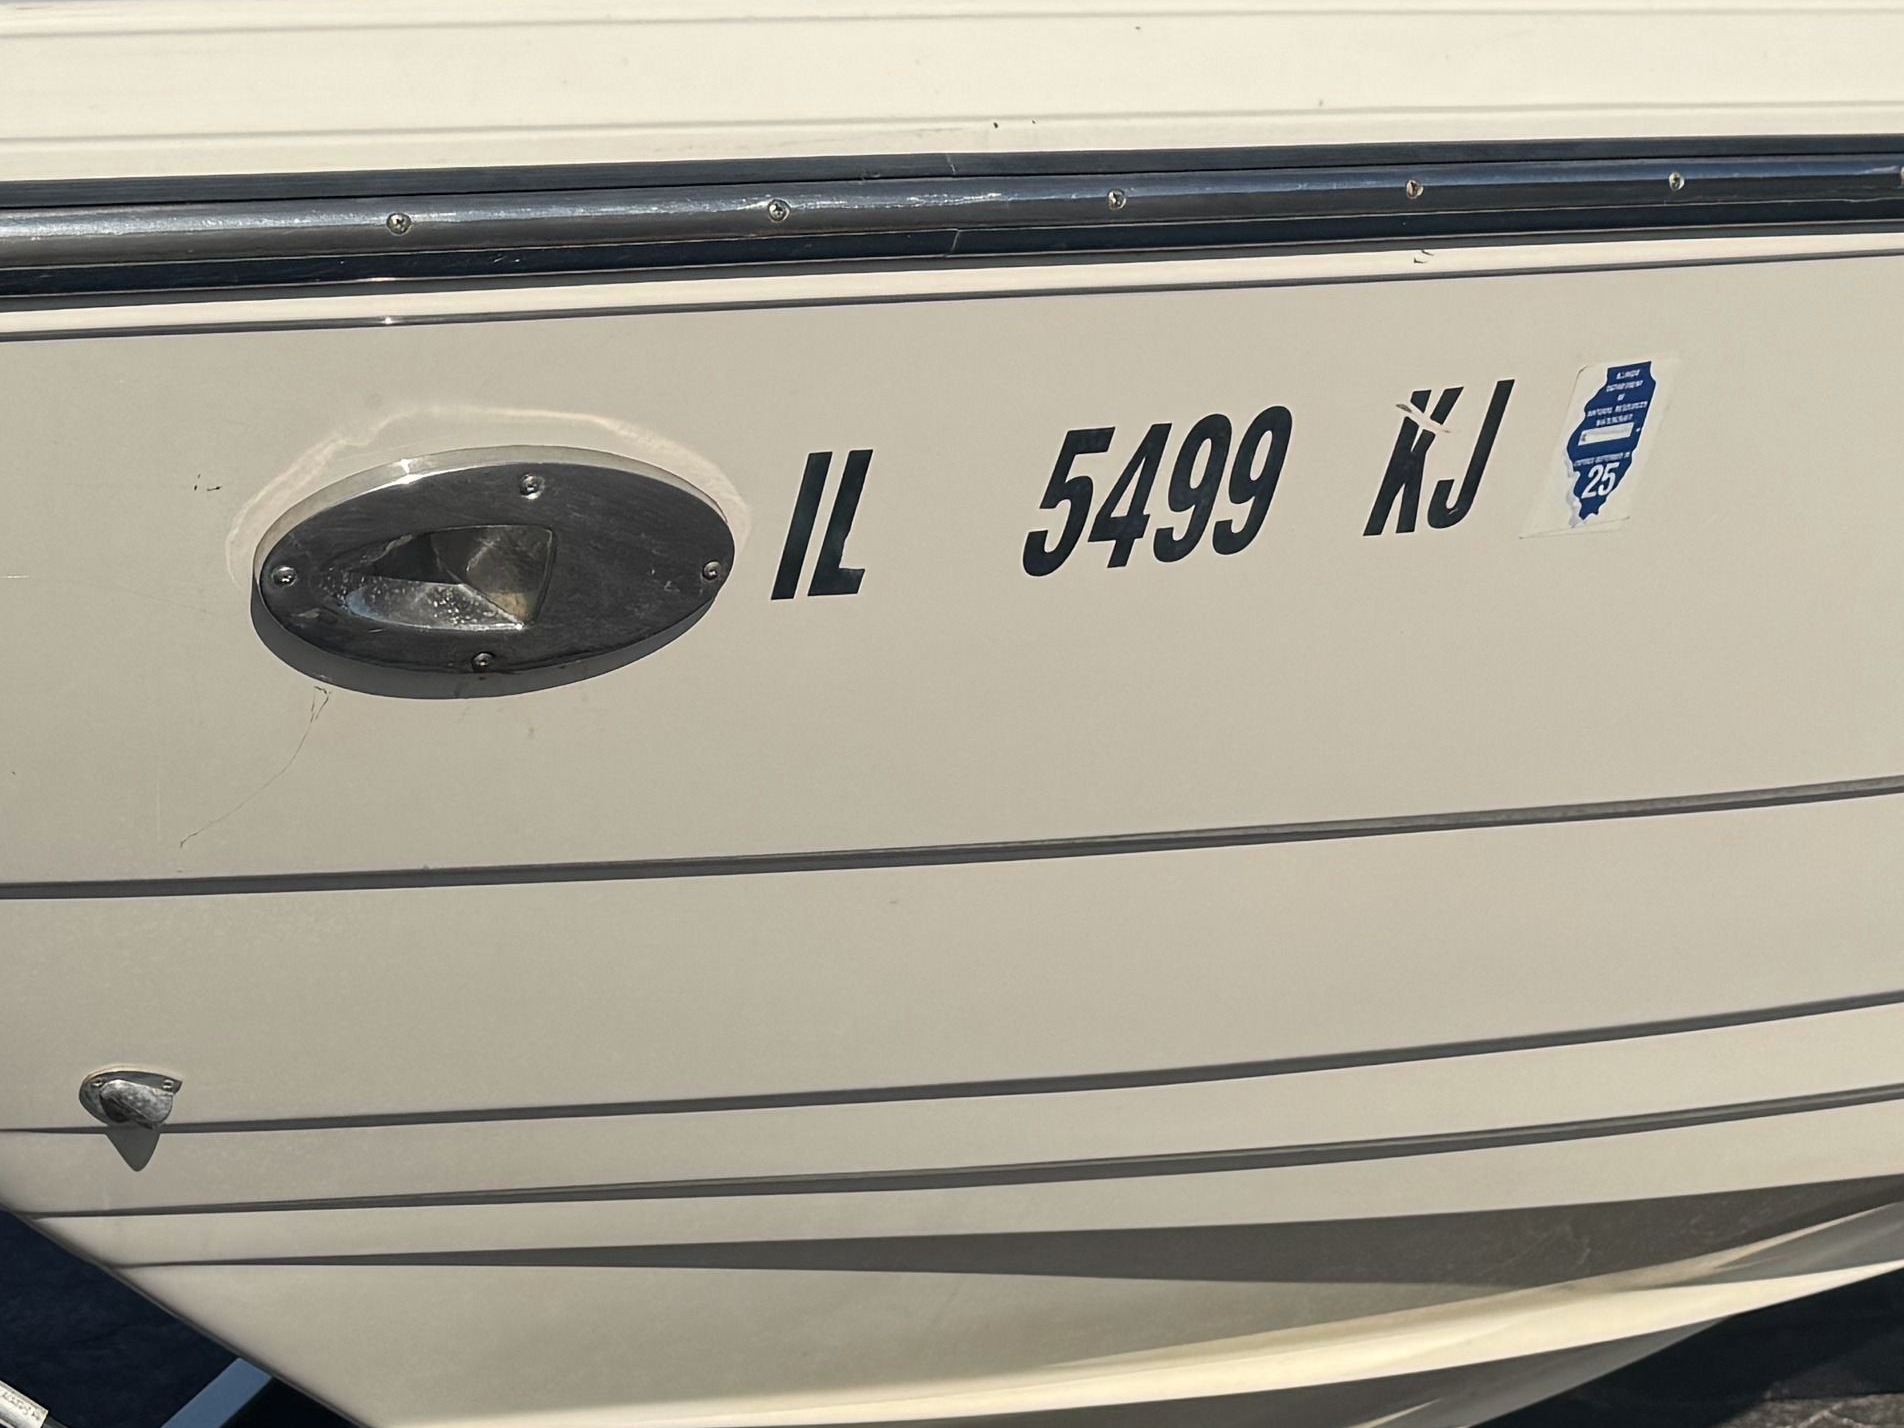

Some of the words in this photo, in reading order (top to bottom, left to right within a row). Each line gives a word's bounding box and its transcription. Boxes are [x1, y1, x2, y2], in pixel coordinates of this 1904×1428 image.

[770, 449, 874, 600] IL
[1022, 405, 1293, 577] 5499
[1362, 378, 1516, 537] KJ
[1581, 462, 1620, 499] 25
